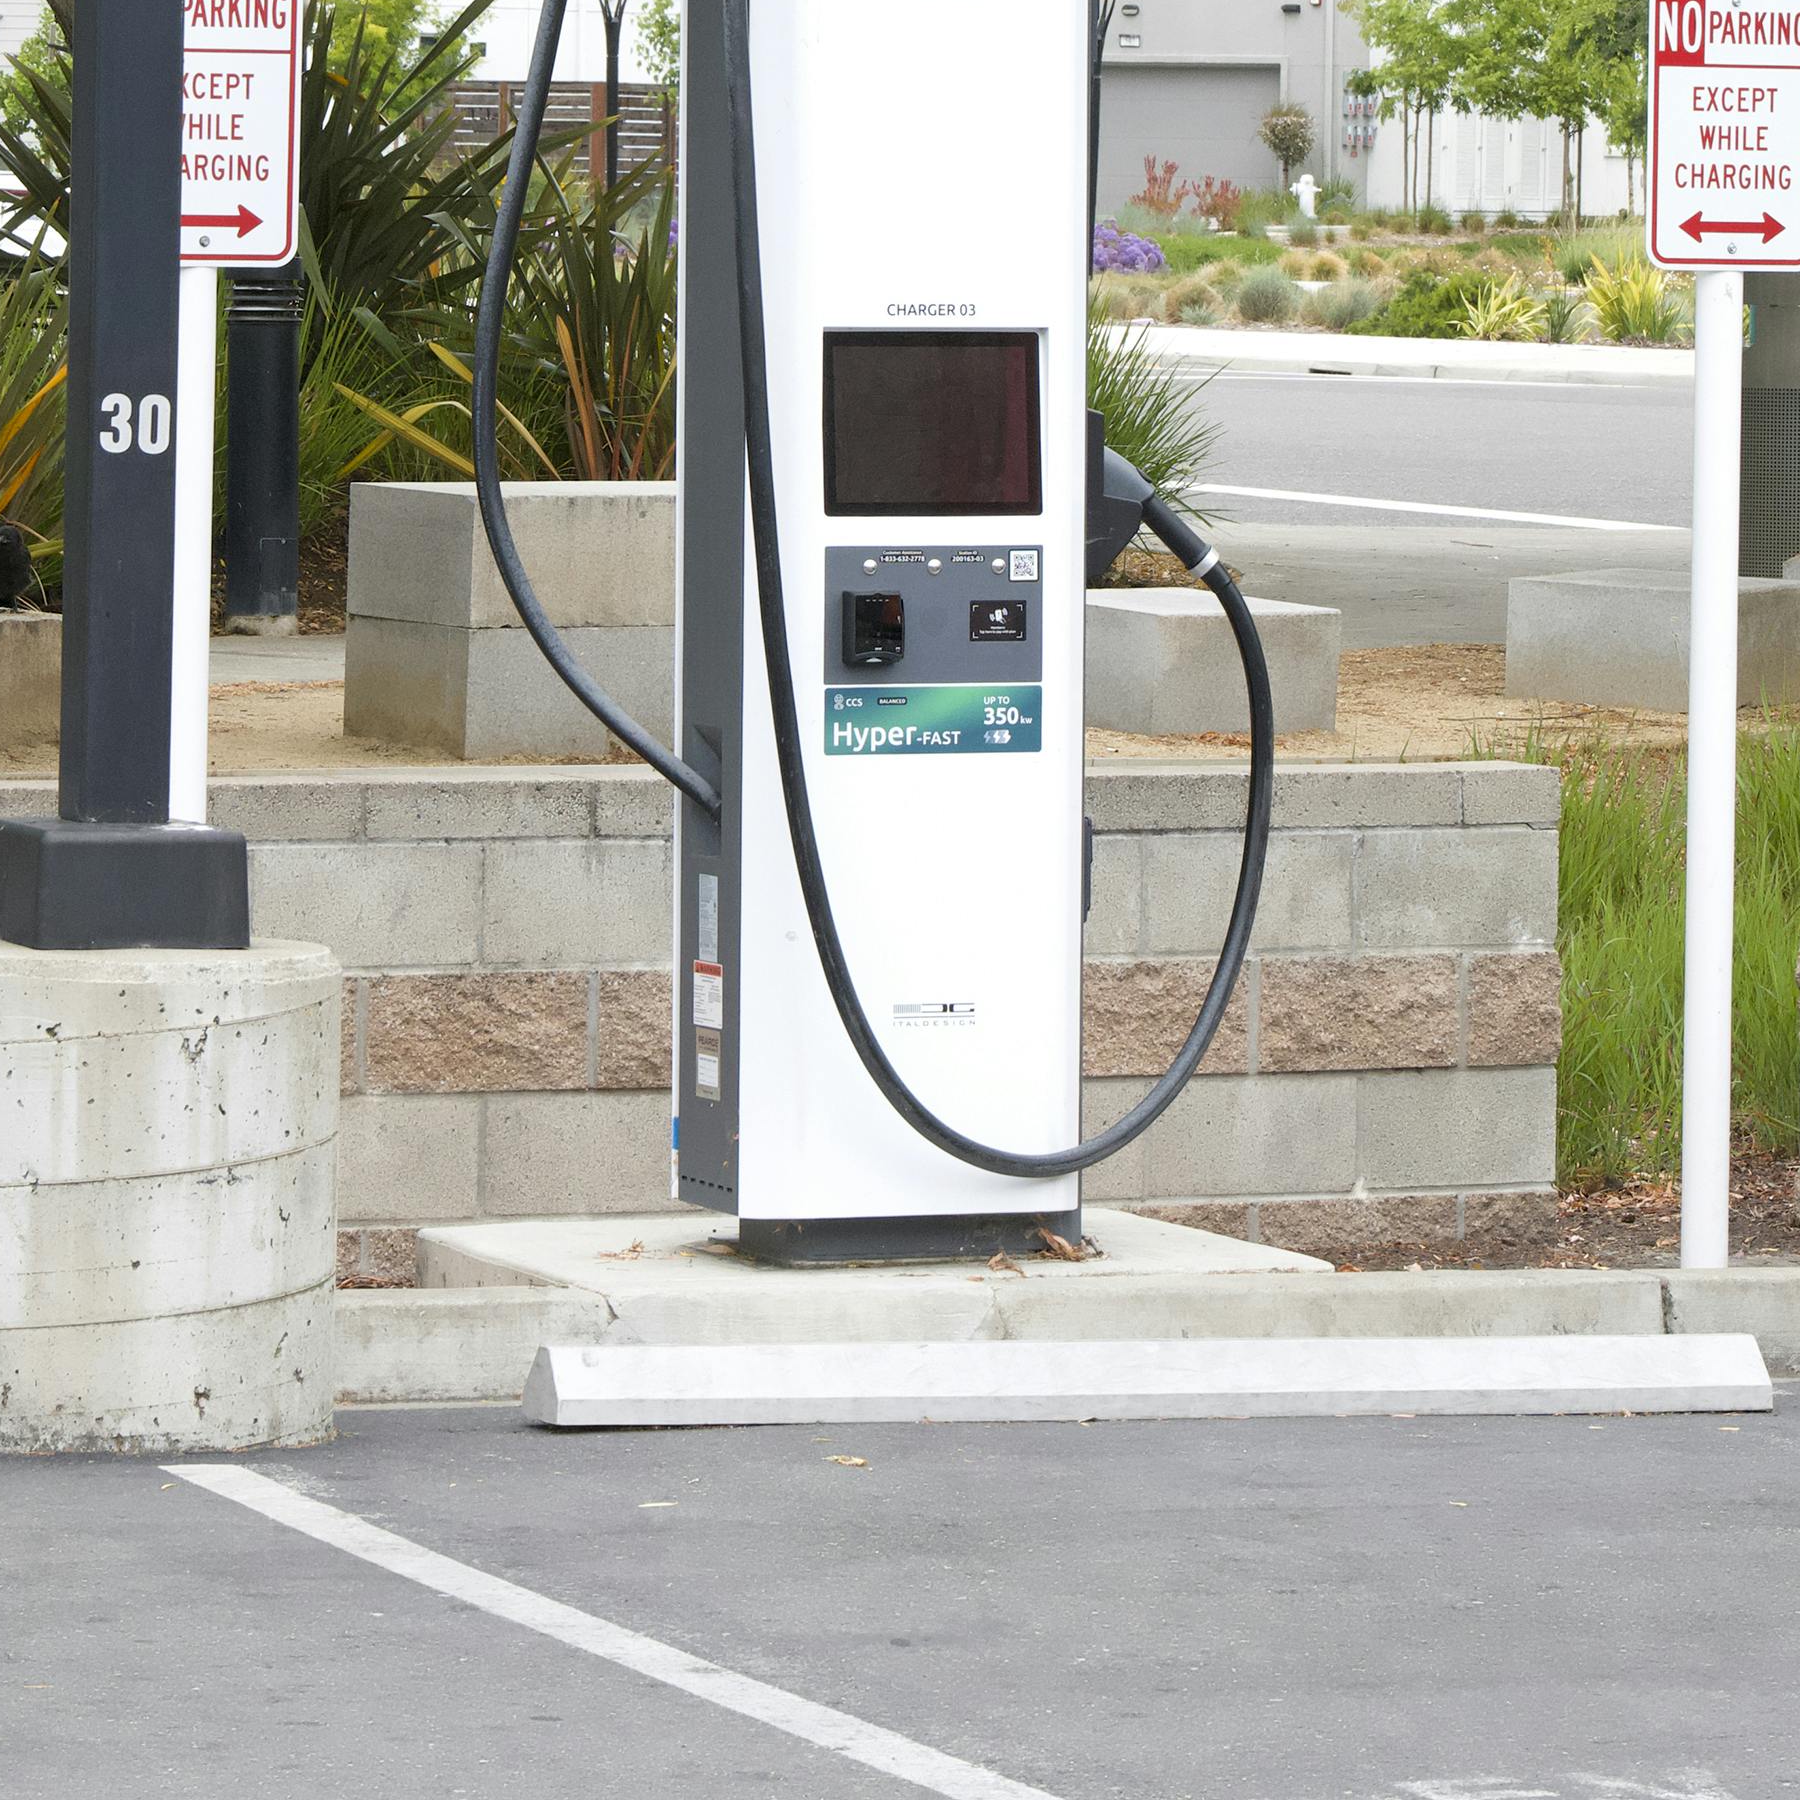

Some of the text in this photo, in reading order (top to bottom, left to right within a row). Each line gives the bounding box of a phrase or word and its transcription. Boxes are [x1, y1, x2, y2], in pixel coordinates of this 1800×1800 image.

[1659, 0, 1702, 53] NO
[1692, 86, 1779, 113] EXCEPT
[182, 113, 245, 140] HILE
[1699, 124, 1769, 152] WHILE
[180, 154, 269, 181] ARGING
[1674, 163, 1791, 190] CHARGING
[887, 303, 976, 317] CHARGER 03
[99, 392, 171, 455] 30
[845, 698, 864, 708] CCS
[879, 697, 906, 705] BALANCED
[983, 696, 1011, 705] UP TO
[983, 707, 1019, 725] 350
[833, 722, 961, 752] Hyper-FAST
[892, 1018, 976, 1027] ITALDESIGN
